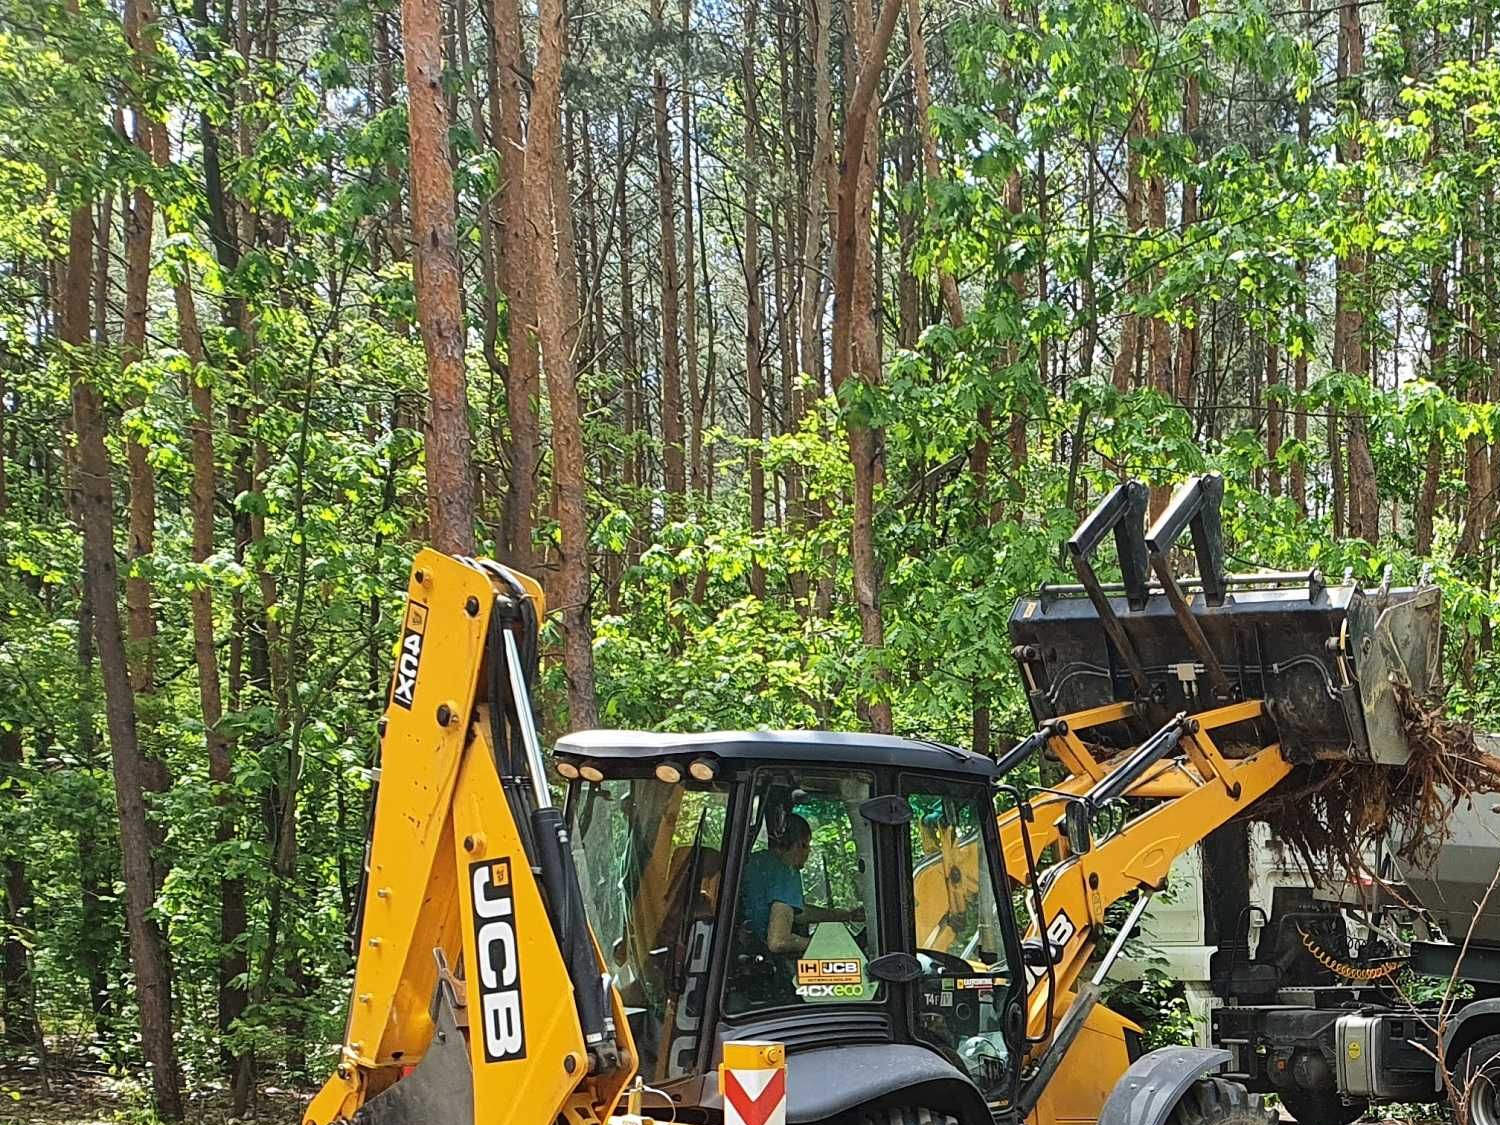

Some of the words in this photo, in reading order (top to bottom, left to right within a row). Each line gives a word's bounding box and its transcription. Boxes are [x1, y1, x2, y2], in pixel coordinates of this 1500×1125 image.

[395, 634, 420, 701] 4CX
[473, 866, 522, 1058] JCB
[801, 964, 817, 973] IH
[822, 962, 857, 973] JCB
